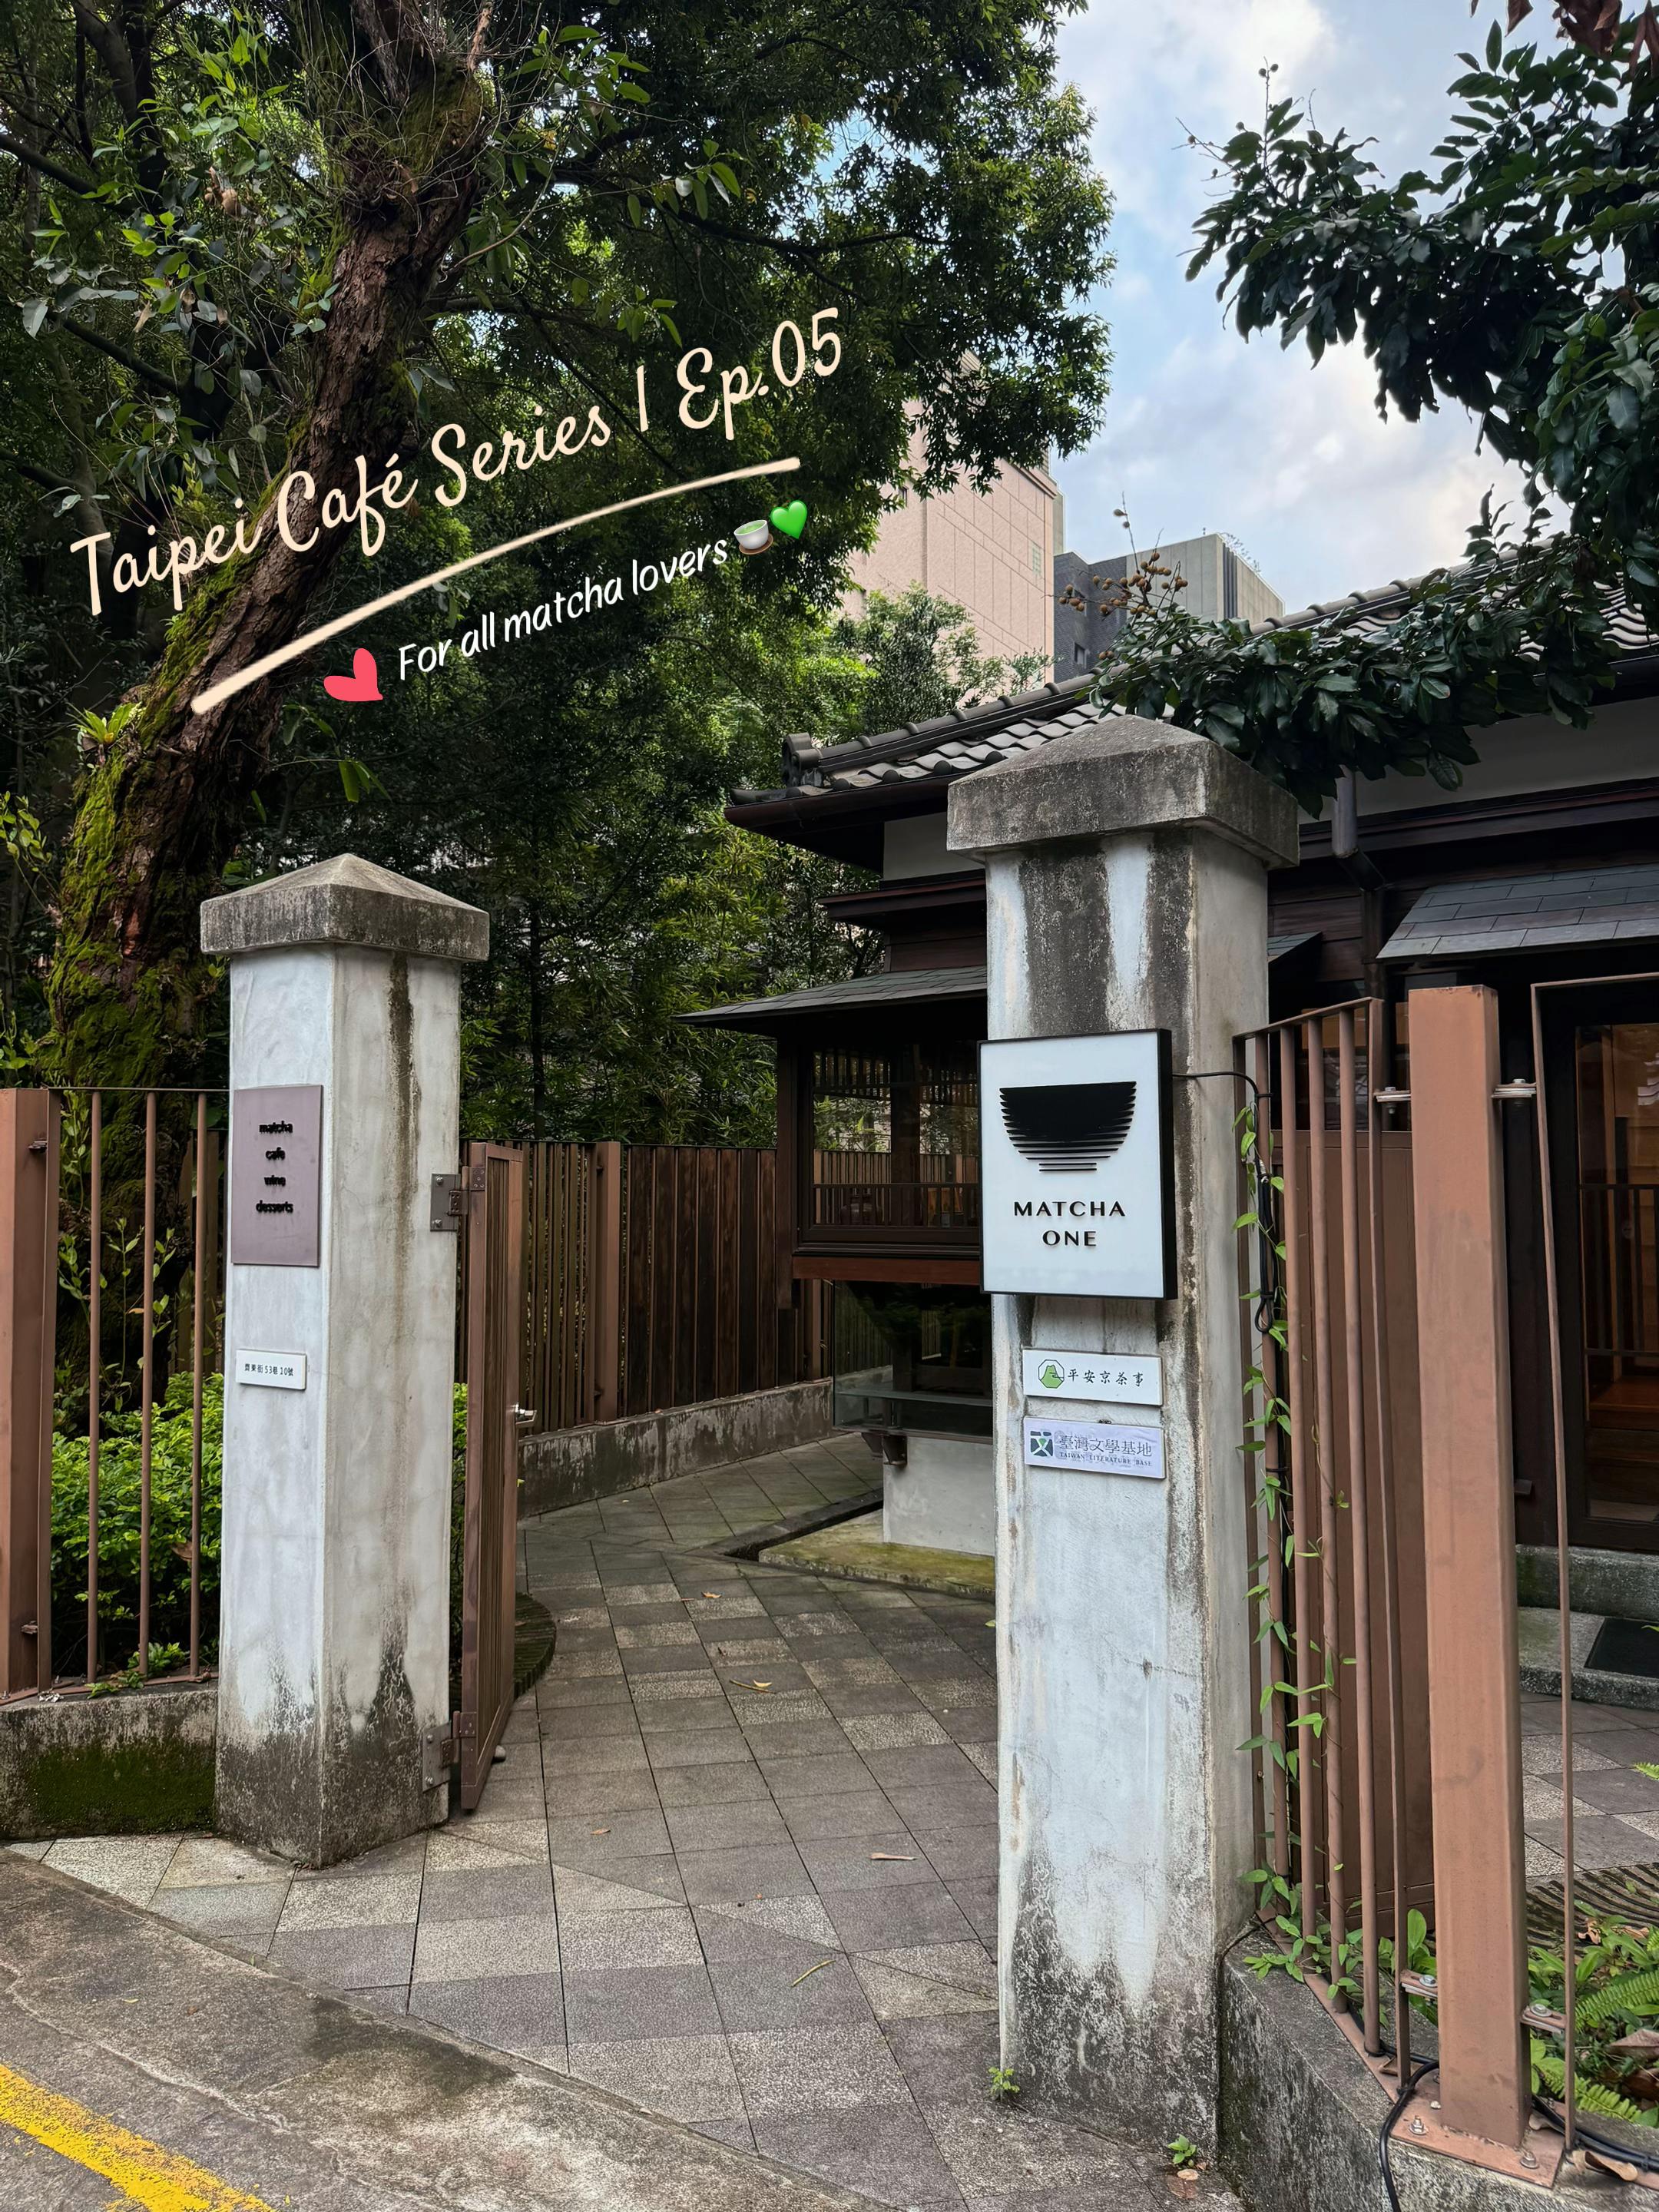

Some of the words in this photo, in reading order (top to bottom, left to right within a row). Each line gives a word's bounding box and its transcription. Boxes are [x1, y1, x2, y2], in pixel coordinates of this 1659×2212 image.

[259, 1120, 293, 1133] matcha
[265, 1147, 286, 1160] cafe
[263, 1175, 286, 1187] wine
[255, 1200, 294, 1214] desserts
[1013, 1200, 1126, 1217] MATCHA
[1041, 1230, 1097, 1247] ONE
[1067, 1369, 1144, 1387] 平安京茶事
[1059, 1435, 1153, 1458] 臺灣文學基地
[1060, 1452, 1085, 1460] TAIWAN
[1089, 1454, 1131, 1465] LITERATURE
